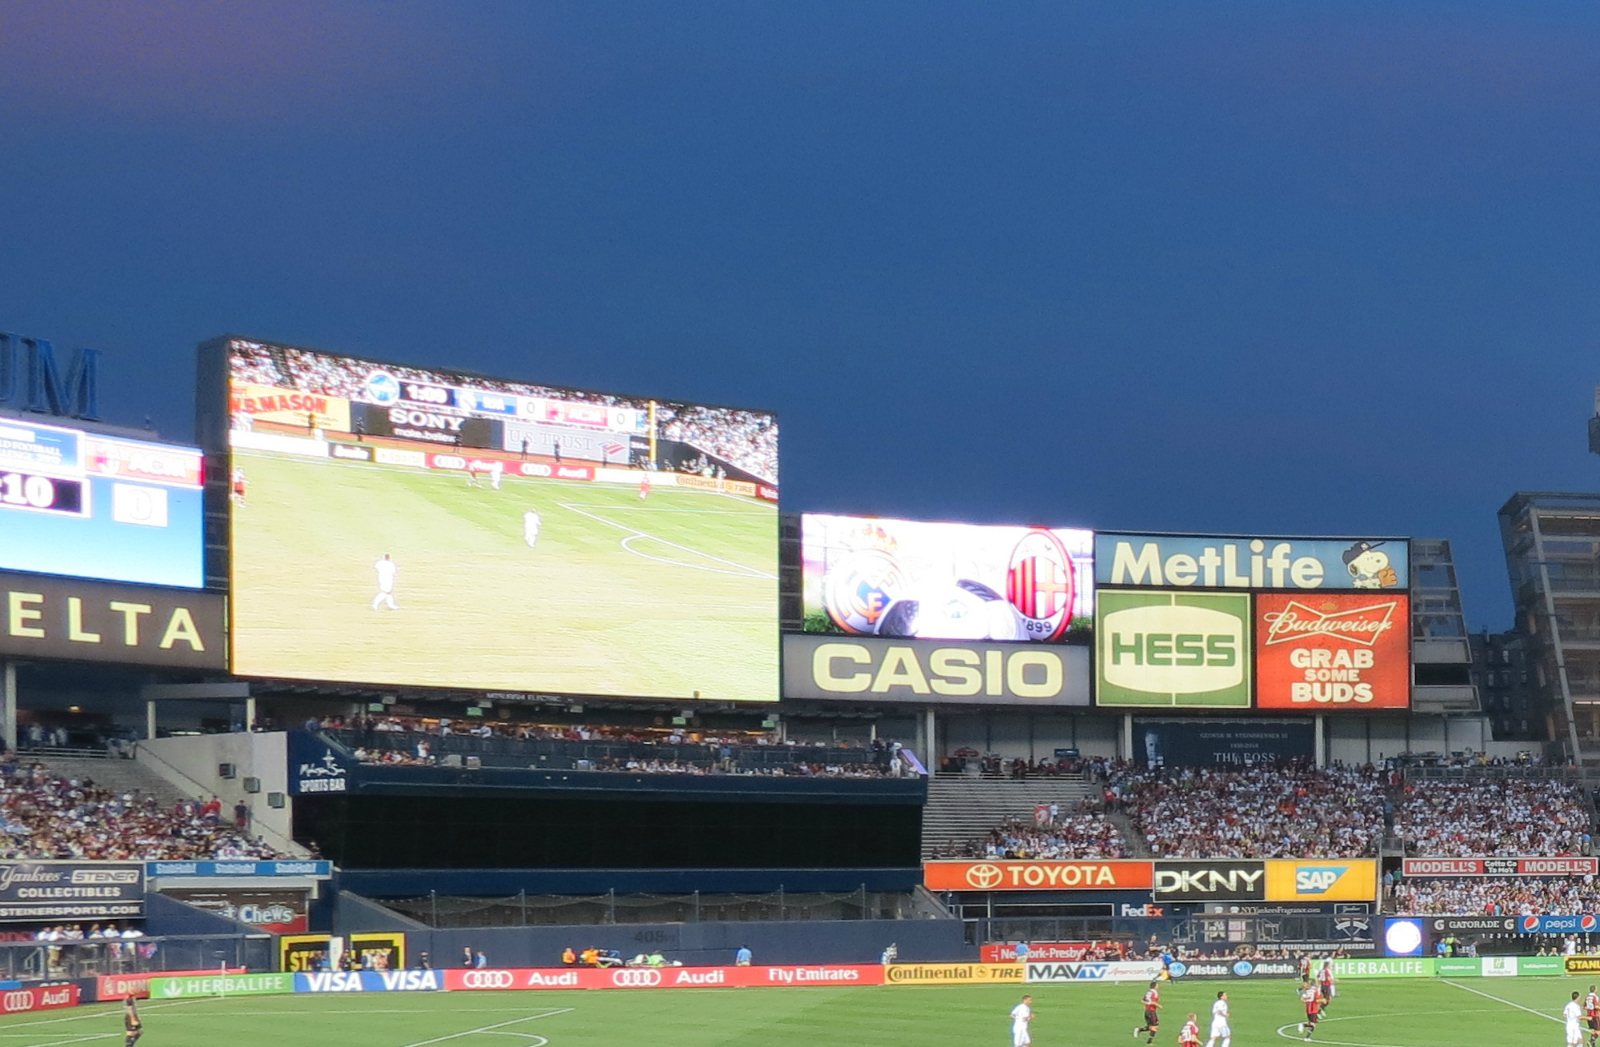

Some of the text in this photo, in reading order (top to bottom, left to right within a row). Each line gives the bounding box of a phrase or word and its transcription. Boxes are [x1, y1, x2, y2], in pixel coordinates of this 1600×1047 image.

[388, 407, 465, 432] SONY
[542, 433, 593, 451] TRUST
[1110, 538, 1325, 589] MetLife
[1263, 609, 1394, 636] Budweiser
[1111, 632, 1236, 668] HESS
[1289, 648, 1375, 670] GRAB
[812, 643, 1064, 699] CASIO
[1304, 669, 1360, 683] SOME
[1290, 682, 1374, 704] BUDS
[300, 778, 346, 792] SPORTS BAR
[1007, 865, 1116, 886] TOYOTA
[1409, 861, 1477, 874] MODELL'S
[1524, 861, 1592, 873] MODELL'S
[73, 871, 138, 883] STEINER
[1155, 869, 1264, 893] DKNY
[1296, 870, 1337, 890] SAP
[18, 886, 121, 898] COLLECTIBLES
[240, 906, 293, 923] Chews
[1121, 903, 1163, 917] FedEx
[1449, 920, 1500, 929] GATORADE
[1545, 918, 1576, 930] pepsi
[769, 967, 859, 984] Fly Emirates
[887, 965, 1024, 982] Continental TIRE
[1186, 964, 1229, 975] Allstate
[1252, 963, 1295, 975] Allstate
[1333, 961, 1424, 975] HERBALIFE
[187, 976, 284, 993] HERBALIFE
[303, 972, 364, 992] VISA
[379, 970, 437, 990] VISA
[527, 971, 578, 987] Audi
[676, 970, 725, 985] Audi
[41, 989, 70, 1006] Audi
